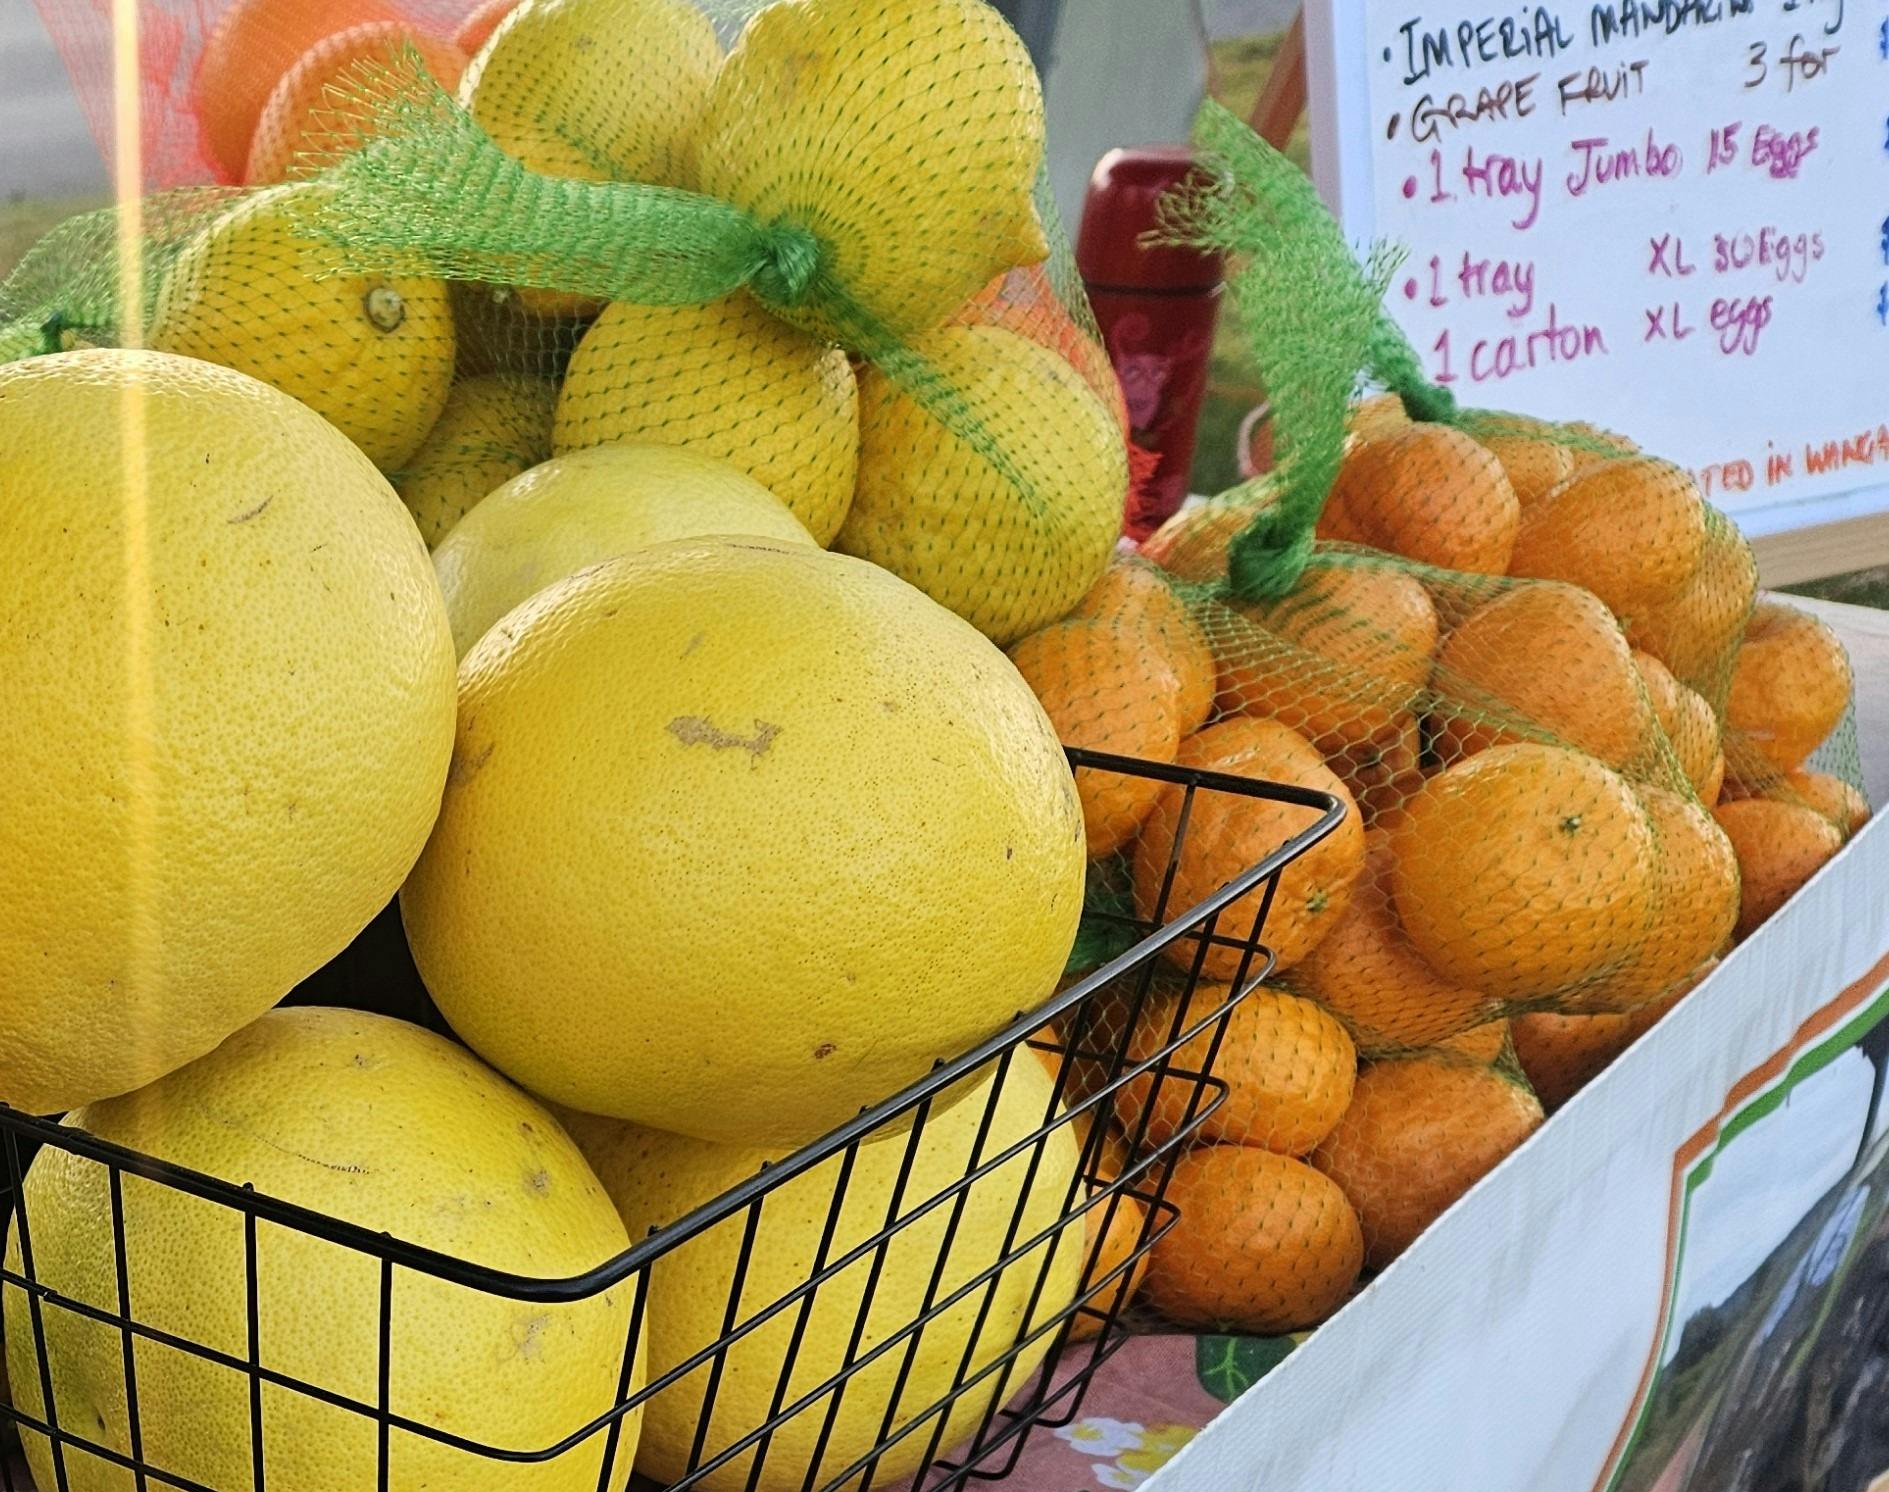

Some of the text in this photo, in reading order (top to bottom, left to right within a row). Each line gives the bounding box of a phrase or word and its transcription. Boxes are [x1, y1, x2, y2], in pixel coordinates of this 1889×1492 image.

[1412, 72, 1540, 143] GRAPE
[1744, 41, 1768, 88] 3
[1779, 33, 1842, 93] for
[1430, 148, 1452, 203] 1
[1462, 145, 1543, 230] tray
[1566, 127, 1683, 197] Jumbo
[1707, 121, 1743, 174] 15
[1429, 251, 1535, 318] 1 tray
[1649, 232, 1696, 277] XL
[1433, 302, 1609, 383] 1 carton
[1644, 295, 1774, 355] XL eggs
[1687, 458, 1755, 497] TED
